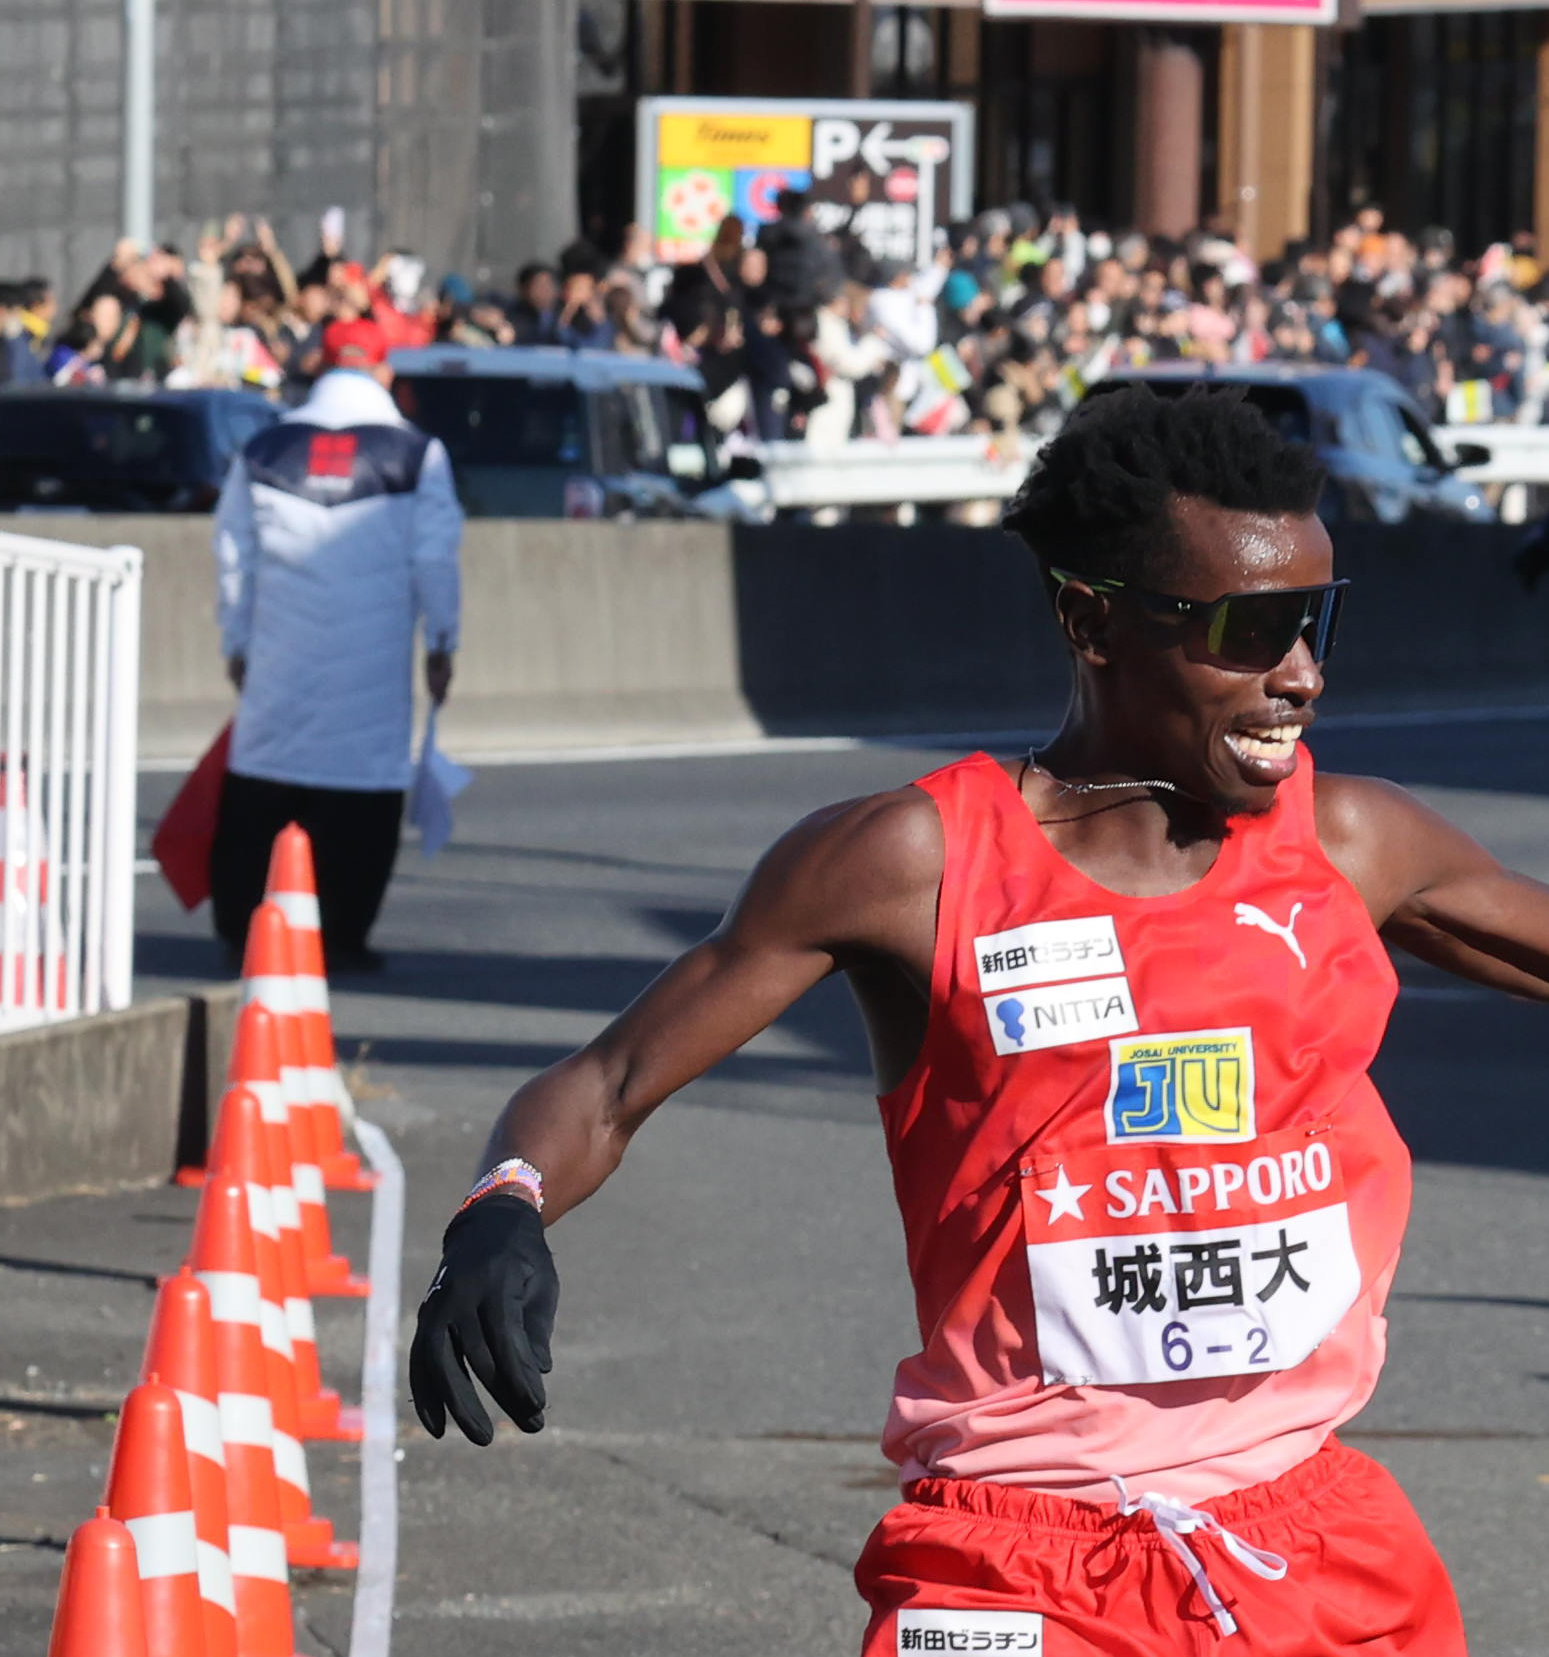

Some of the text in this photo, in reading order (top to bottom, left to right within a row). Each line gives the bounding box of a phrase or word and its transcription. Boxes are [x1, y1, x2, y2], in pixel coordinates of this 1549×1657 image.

[814, 119, 862, 180] P
[1033, 995, 1126, 1029] NITTA
[1130, 1043, 1238, 1060] JOSAI UNIVERSITY
[1121, 1058, 1241, 1134] JU
[1105, 1142, 1332, 1219] SAPPORO
[1091, 1228, 1311, 1316] 城西大
[901, 1627, 1038, 1651] 新田ゼラチン
